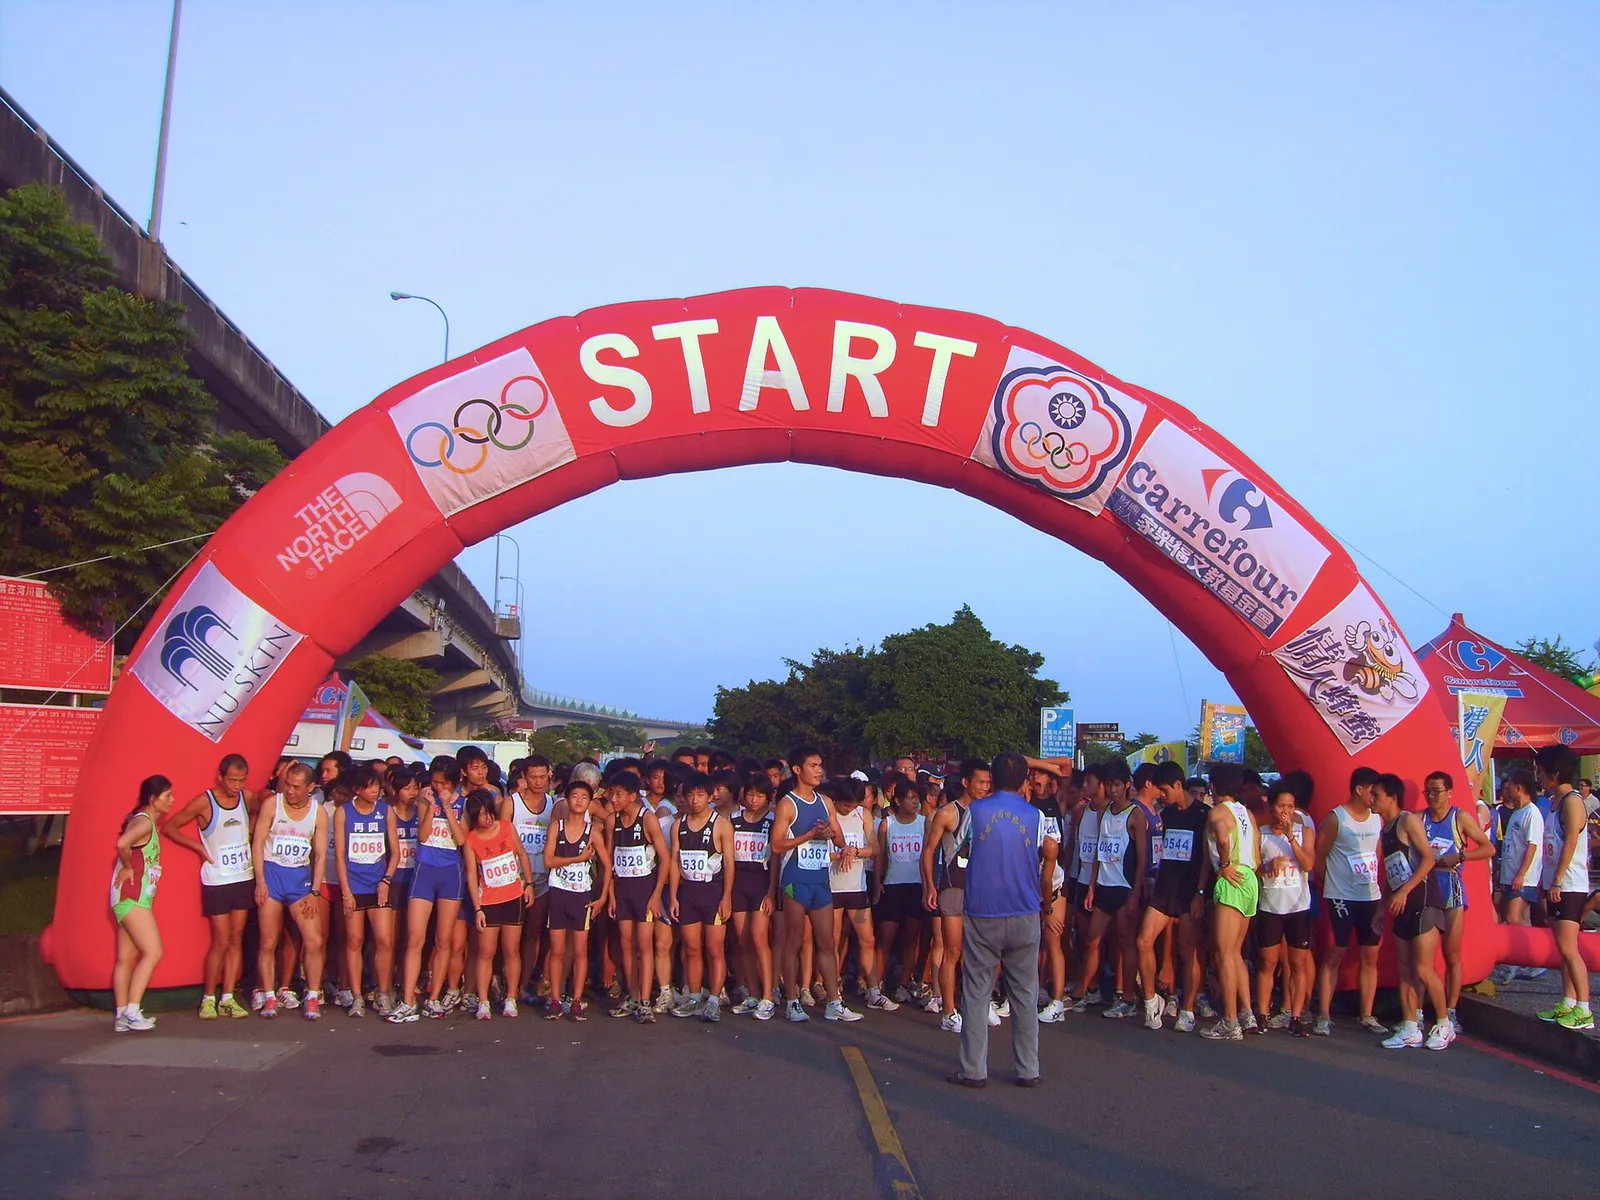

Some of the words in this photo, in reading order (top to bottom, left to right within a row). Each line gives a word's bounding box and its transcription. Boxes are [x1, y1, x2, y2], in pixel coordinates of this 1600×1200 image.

[579, 315, 978, 428] START
[294, 485, 343, 526] THE
[276, 502, 355, 572] NORTH
[1125, 461, 1298, 610] Carrefour
[309, 517, 370, 571] FACE
[1043, 709, 1057, 729] P
[276, 844, 309, 857] 0097
[352, 842, 383, 853] 0068
[735, 840, 765, 852] 0180
[801, 848, 828, 860] 0367
[892, 842, 920, 853] 0110
[616, 855, 643, 867] 0528
[682, 859, 705, 871] 530
[486, 860, 517, 879] 0066
